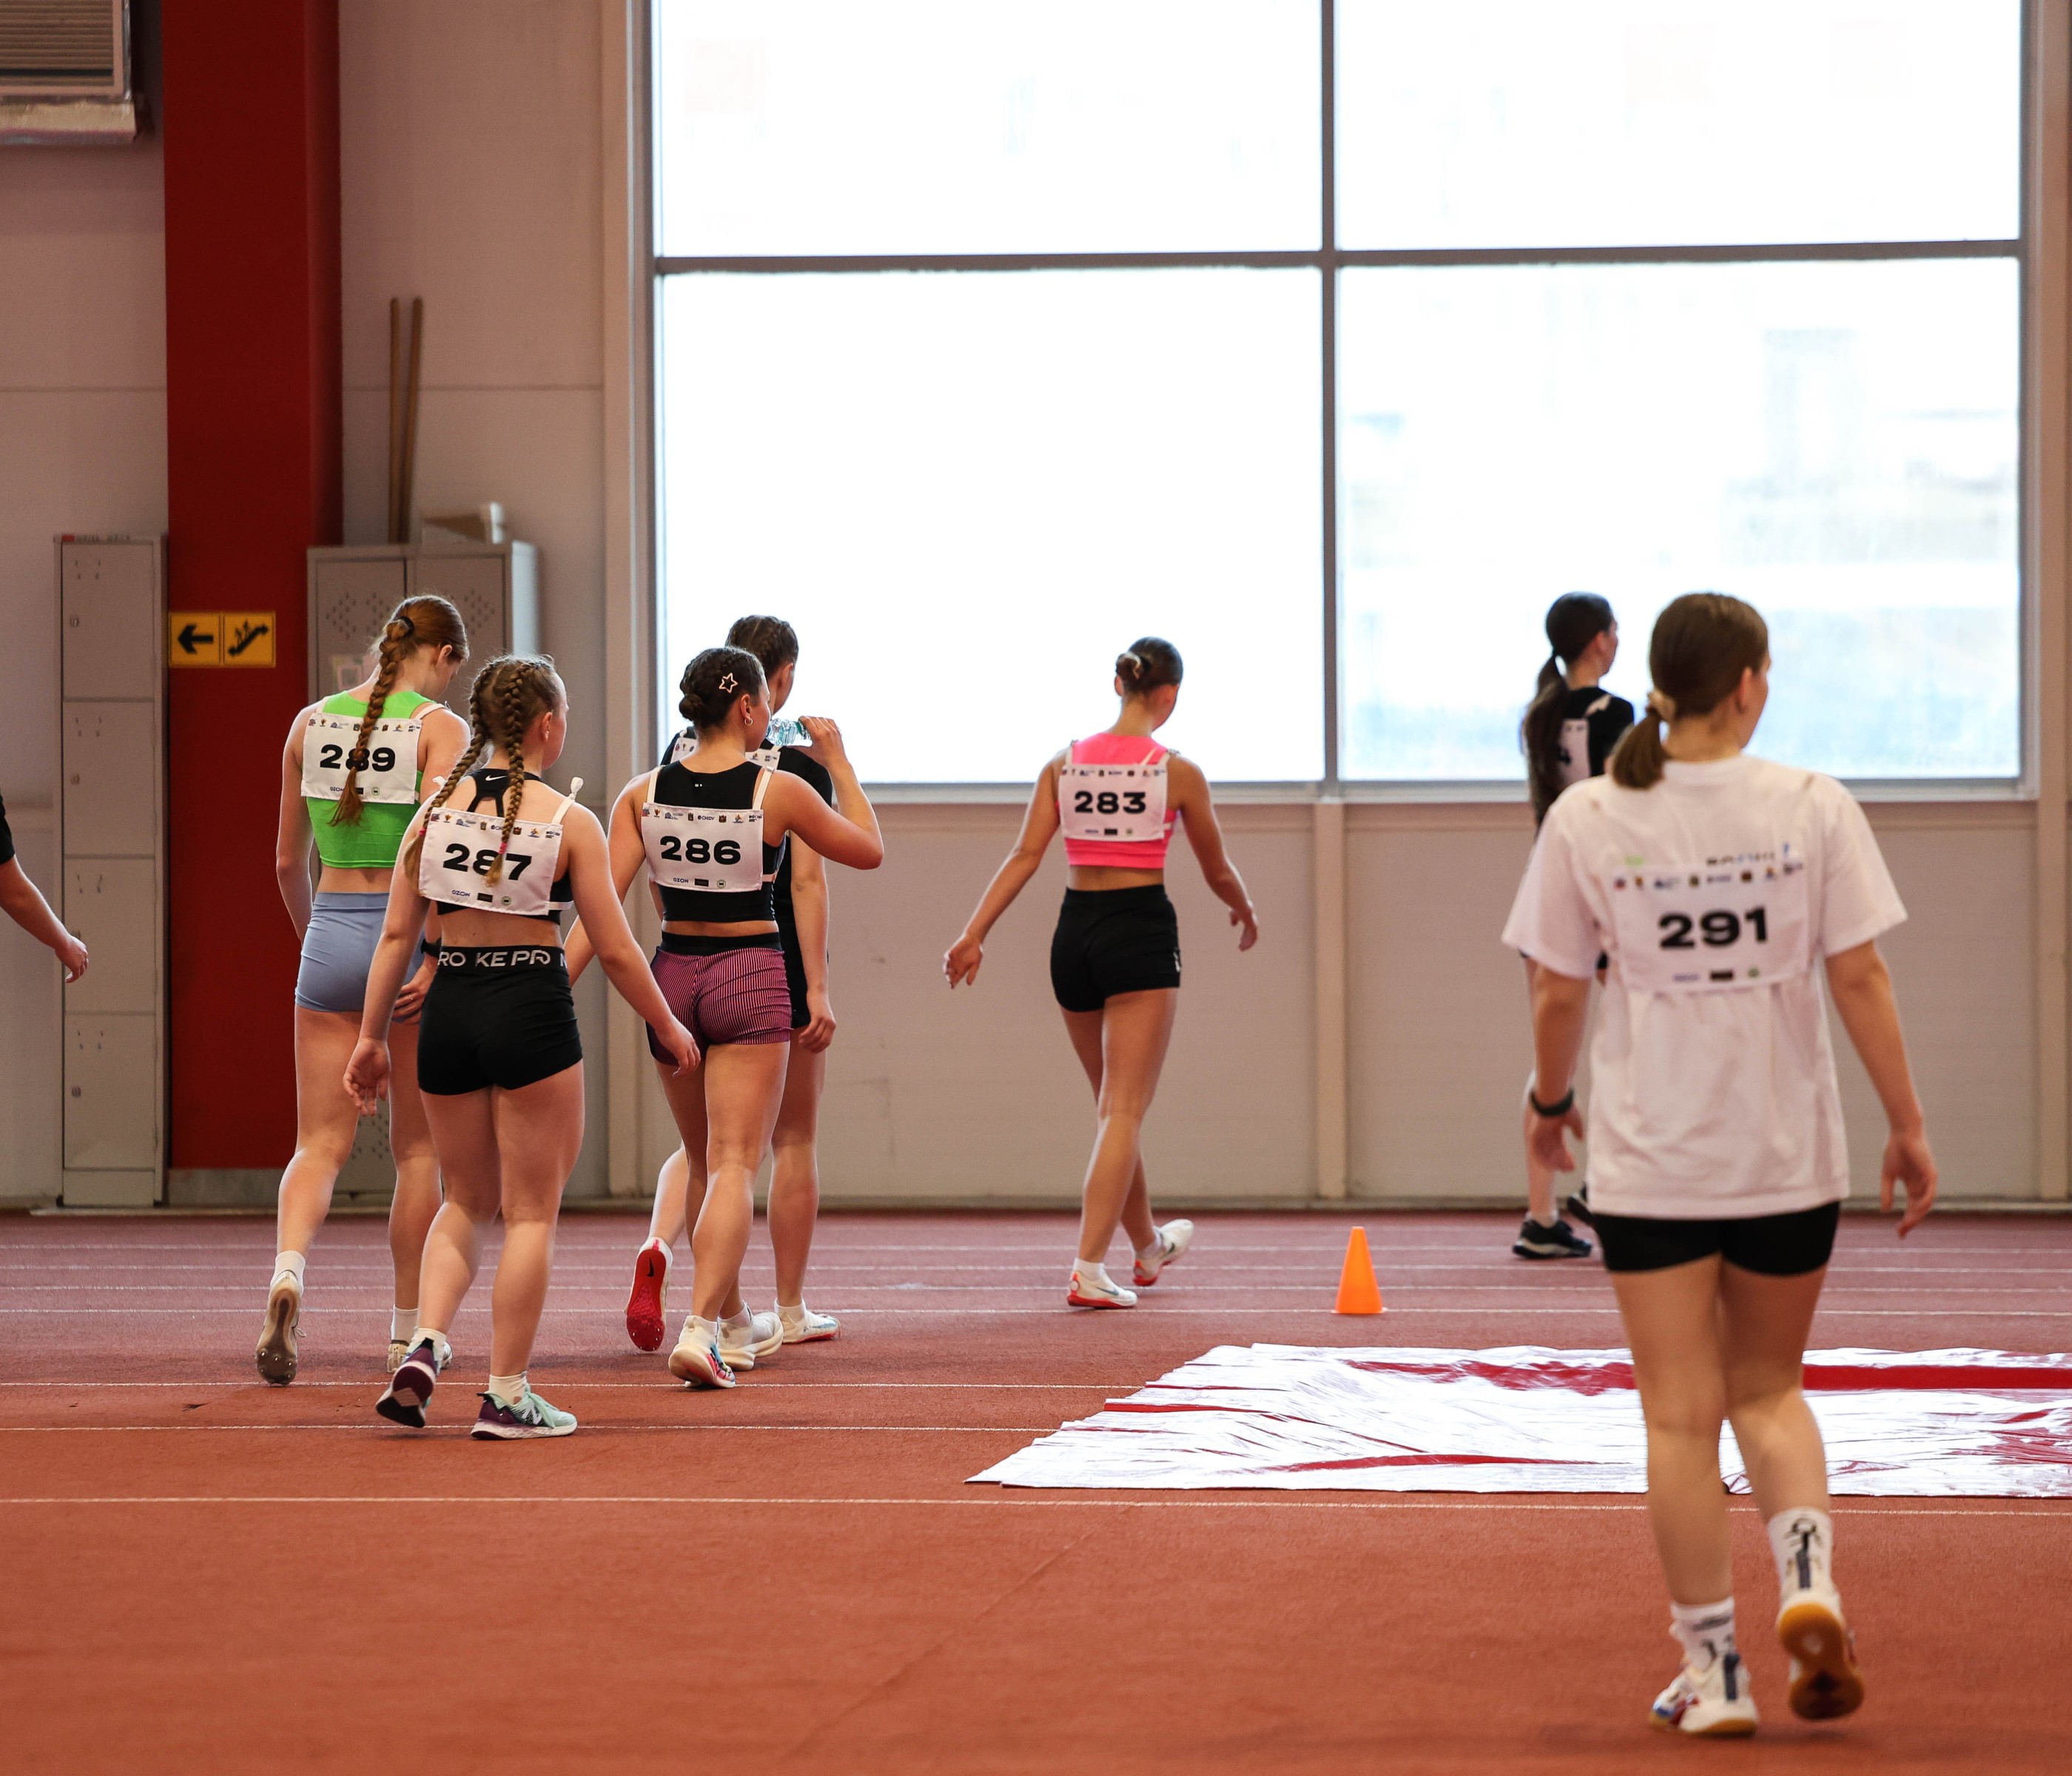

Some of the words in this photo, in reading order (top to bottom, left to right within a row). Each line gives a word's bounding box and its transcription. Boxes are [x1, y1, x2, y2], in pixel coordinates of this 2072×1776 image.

[320, 744, 396, 773] 289
[1074, 790, 1146, 815] 283
[443, 843, 533, 881] 287
[659, 835, 741, 865] 286
[1658, 906, 1768, 950] 291
